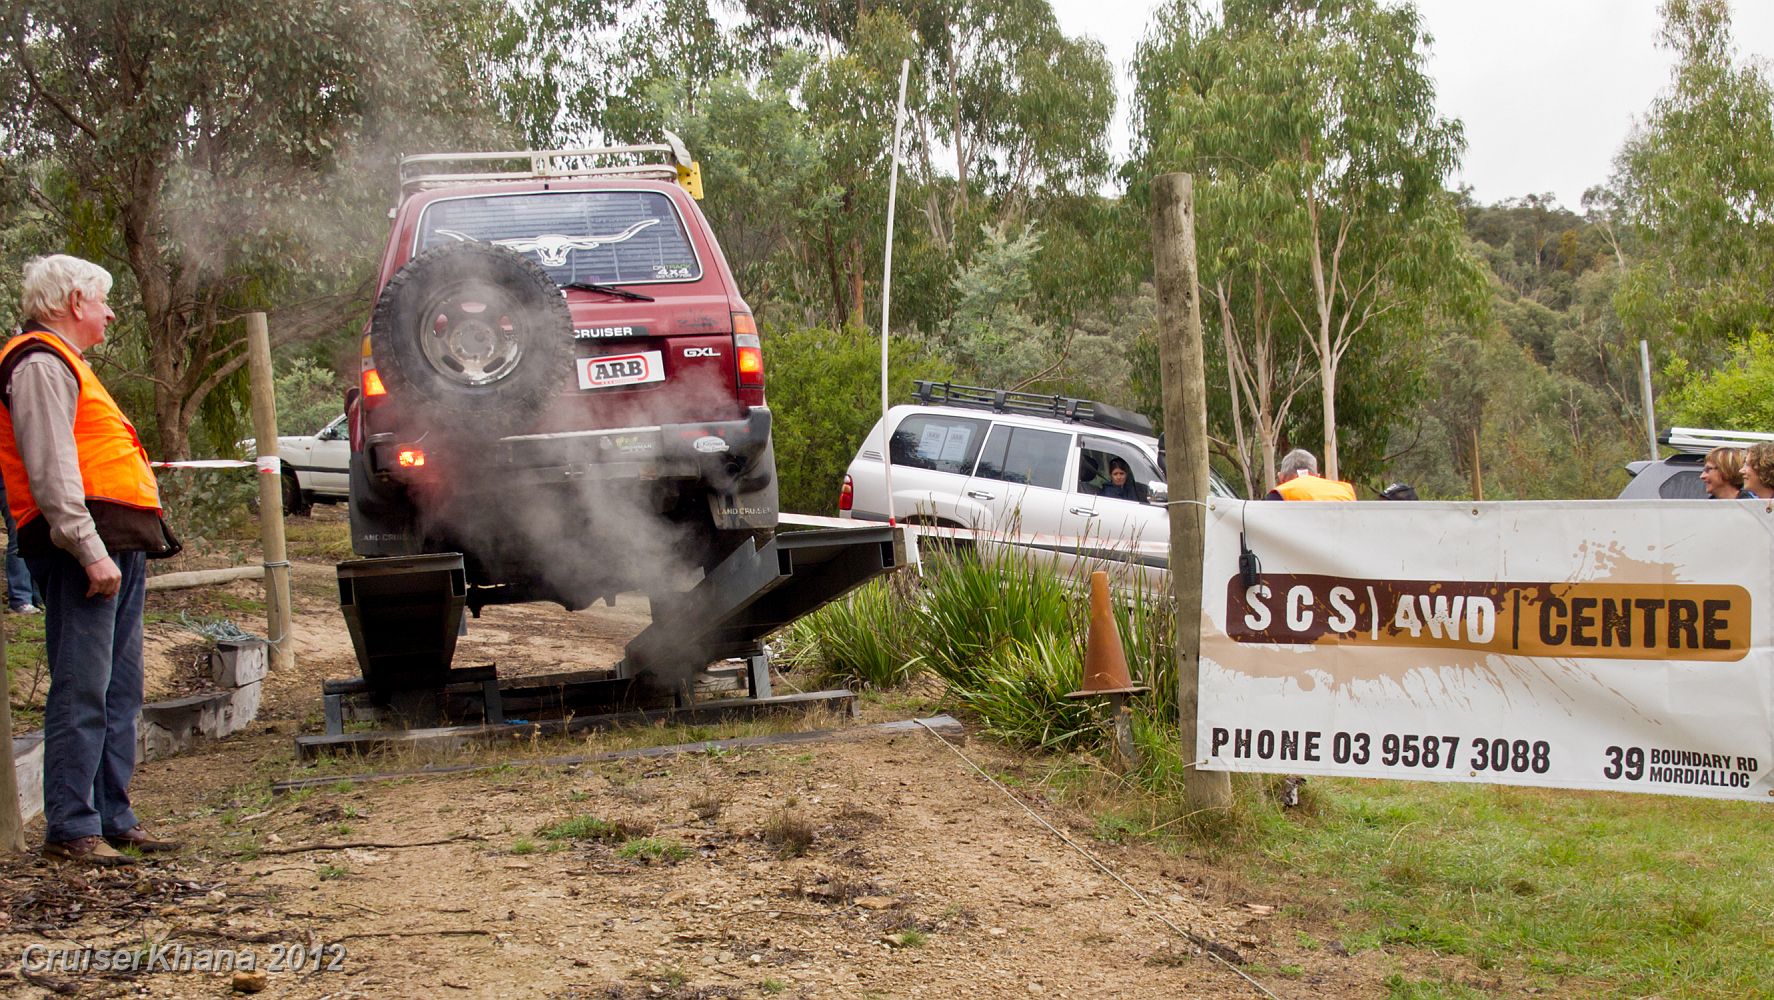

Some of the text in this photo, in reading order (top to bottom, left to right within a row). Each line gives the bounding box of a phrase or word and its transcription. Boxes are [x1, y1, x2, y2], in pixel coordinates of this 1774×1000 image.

[683, 347, 721, 358] GXL
[595, 360, 643, 380] ARB
[1395, 594, 1495, 644] 4WD
[1539, 597, 1731, 650] CENTRE
[1211, 727, 1550, 774] PHONE 03 9587 3088
[1650, 748, 1758, 772] BOUNDARY RD
[1603, 745, 1645, 781] 39
[1649, 766, 1750, 788] MORDIALLOC
